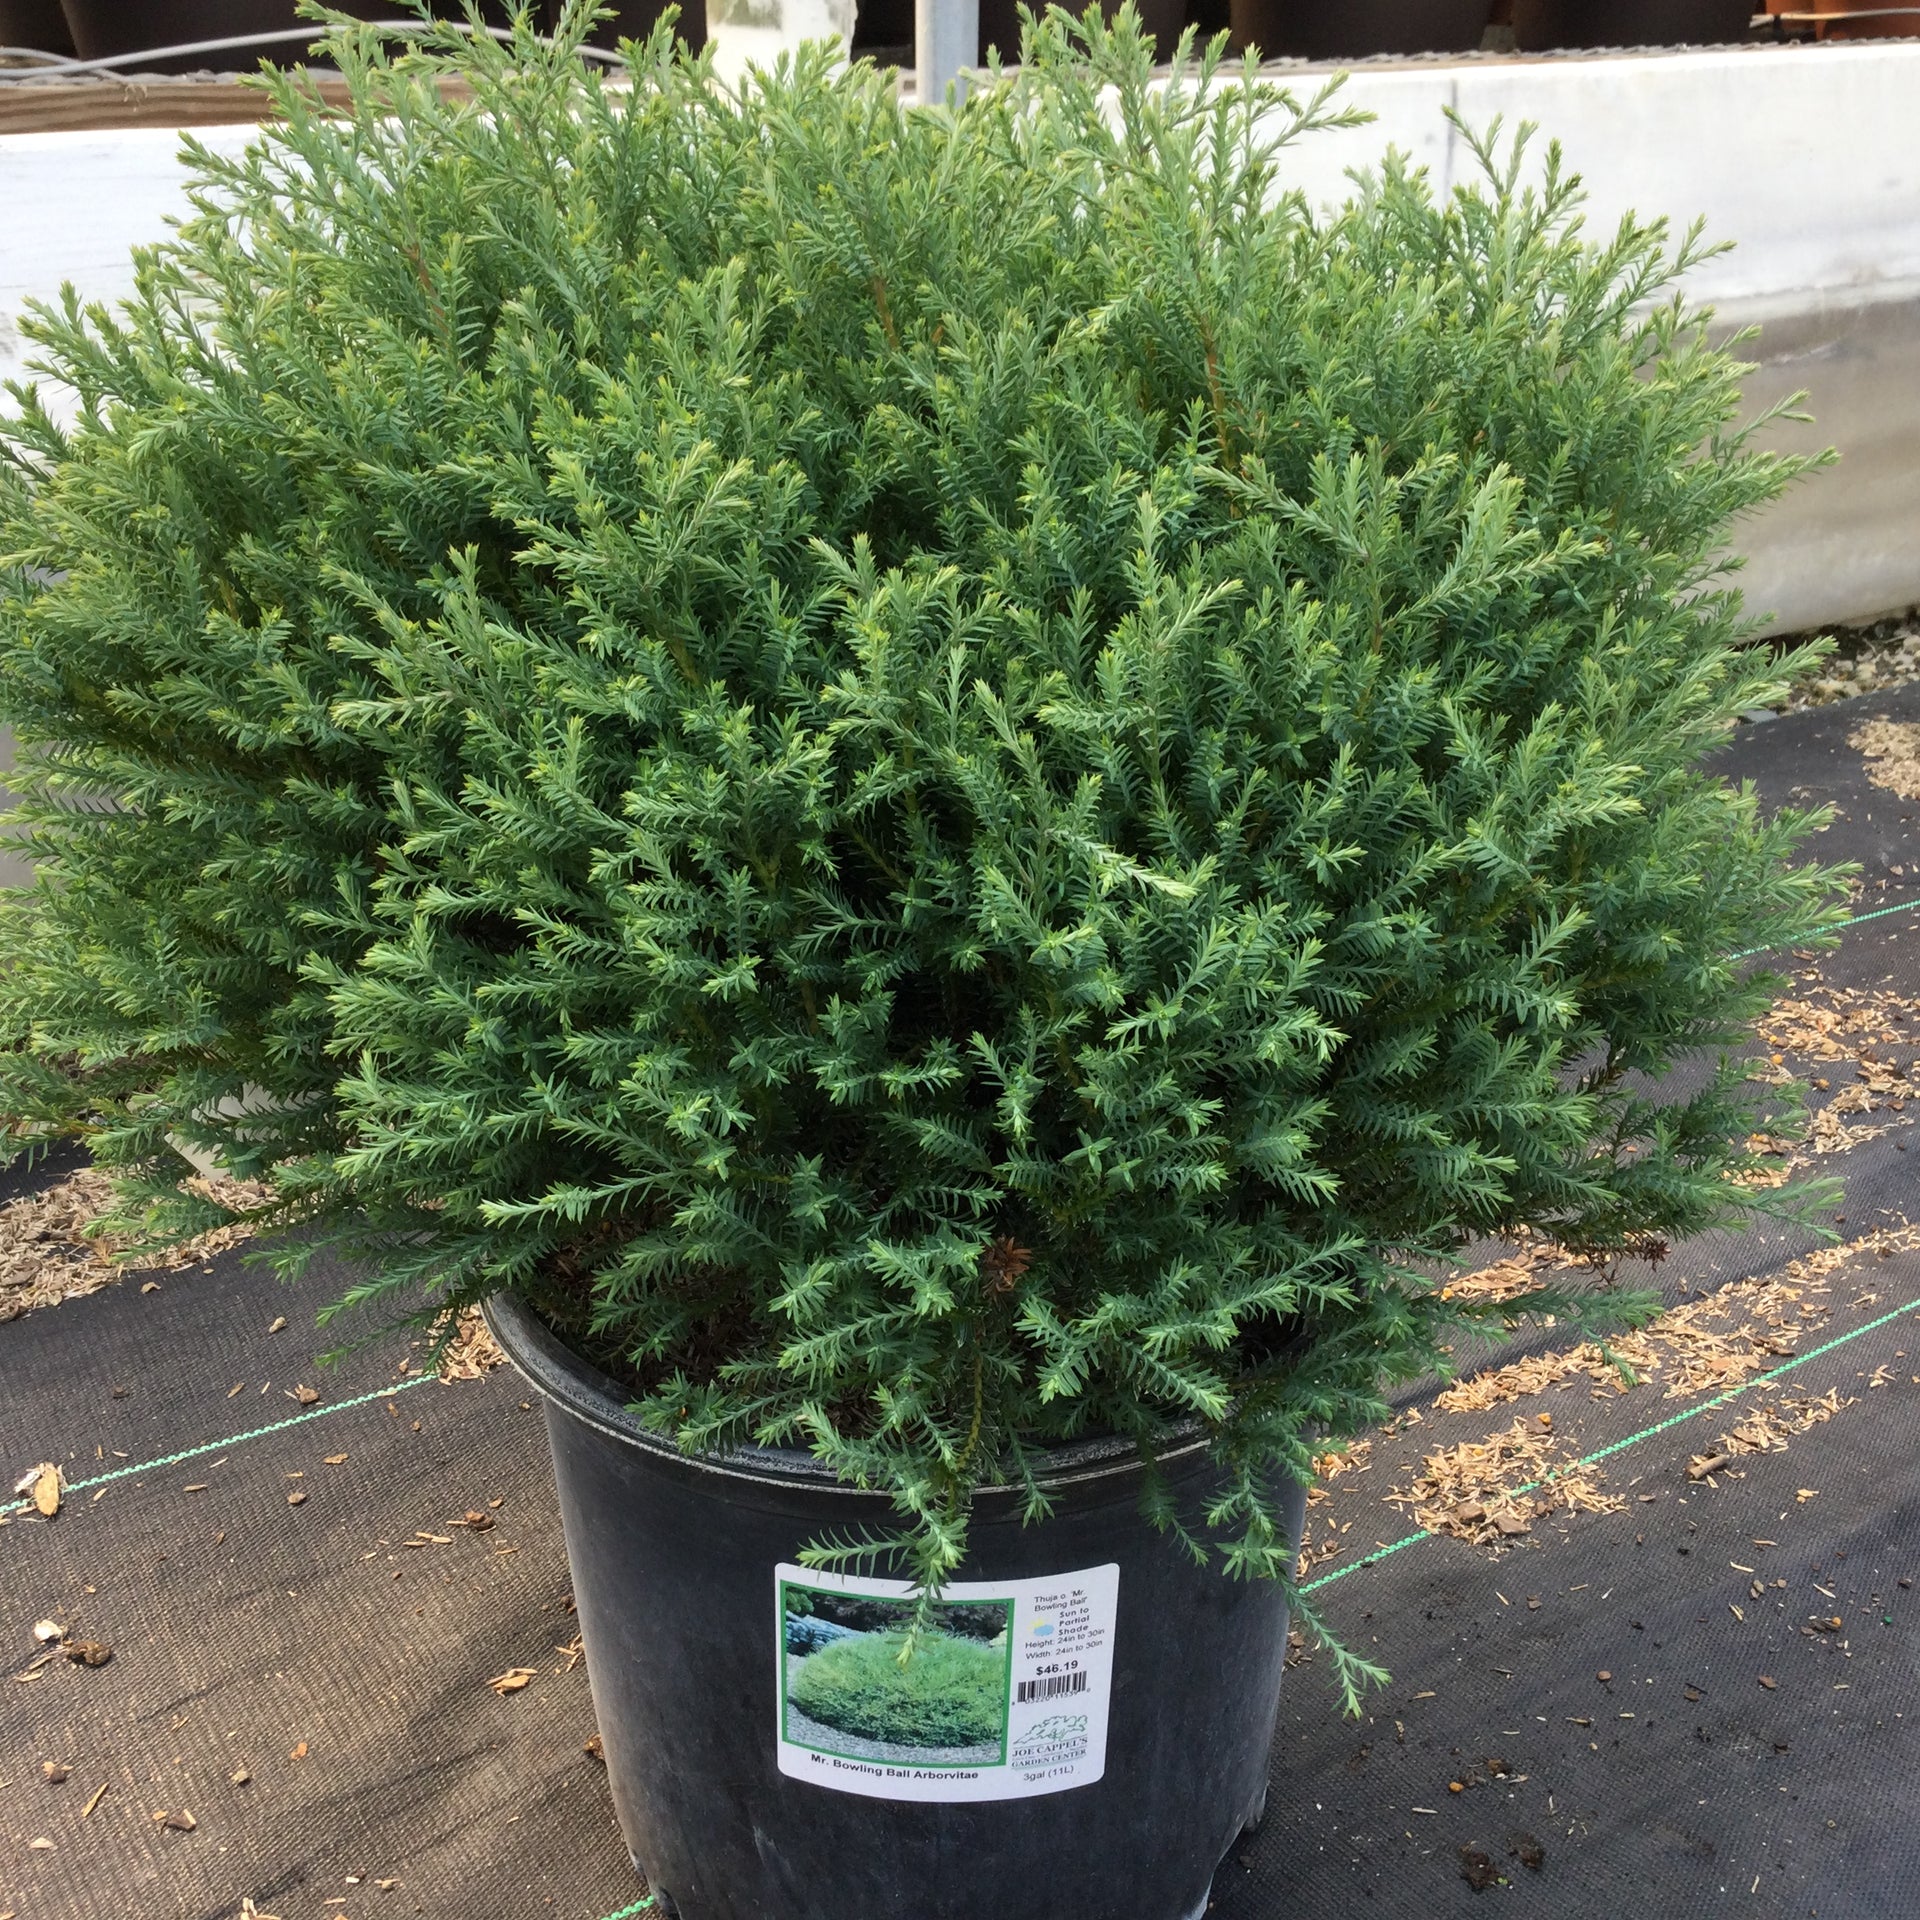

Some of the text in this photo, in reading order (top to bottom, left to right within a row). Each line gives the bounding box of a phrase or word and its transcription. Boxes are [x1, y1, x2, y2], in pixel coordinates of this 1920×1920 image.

[1034, 1594, 1058, 1603] Thuja
[1034, 1601, 1067, 1612] Bowling
[1059, 1615, 1090, 1627] Partial
[1057, 1635, 1076, 1645] 24in
[1088, 1628, 1105, 1638] 30in
[1058, 1625, 1089, 1636] Shade
[1056, 1646, 1074, 1656] 24in
[1075, 1644, 1084, 1652] to
[1086, 1640, 1103, 1649] 30in
[1036, 1660, 1078, 1676] $46.19
[1011, 1757, 1050, 1768] GARDEN
[1051, 1749, 1087, 1761] CENTER
[1012, 1748, 1034, 1757] JOE
[811, 1753, 979, 1780] Mr. Bowling Ball Arborvitae
[1023, 1765, 1075, 1782] 3gal (11L)
